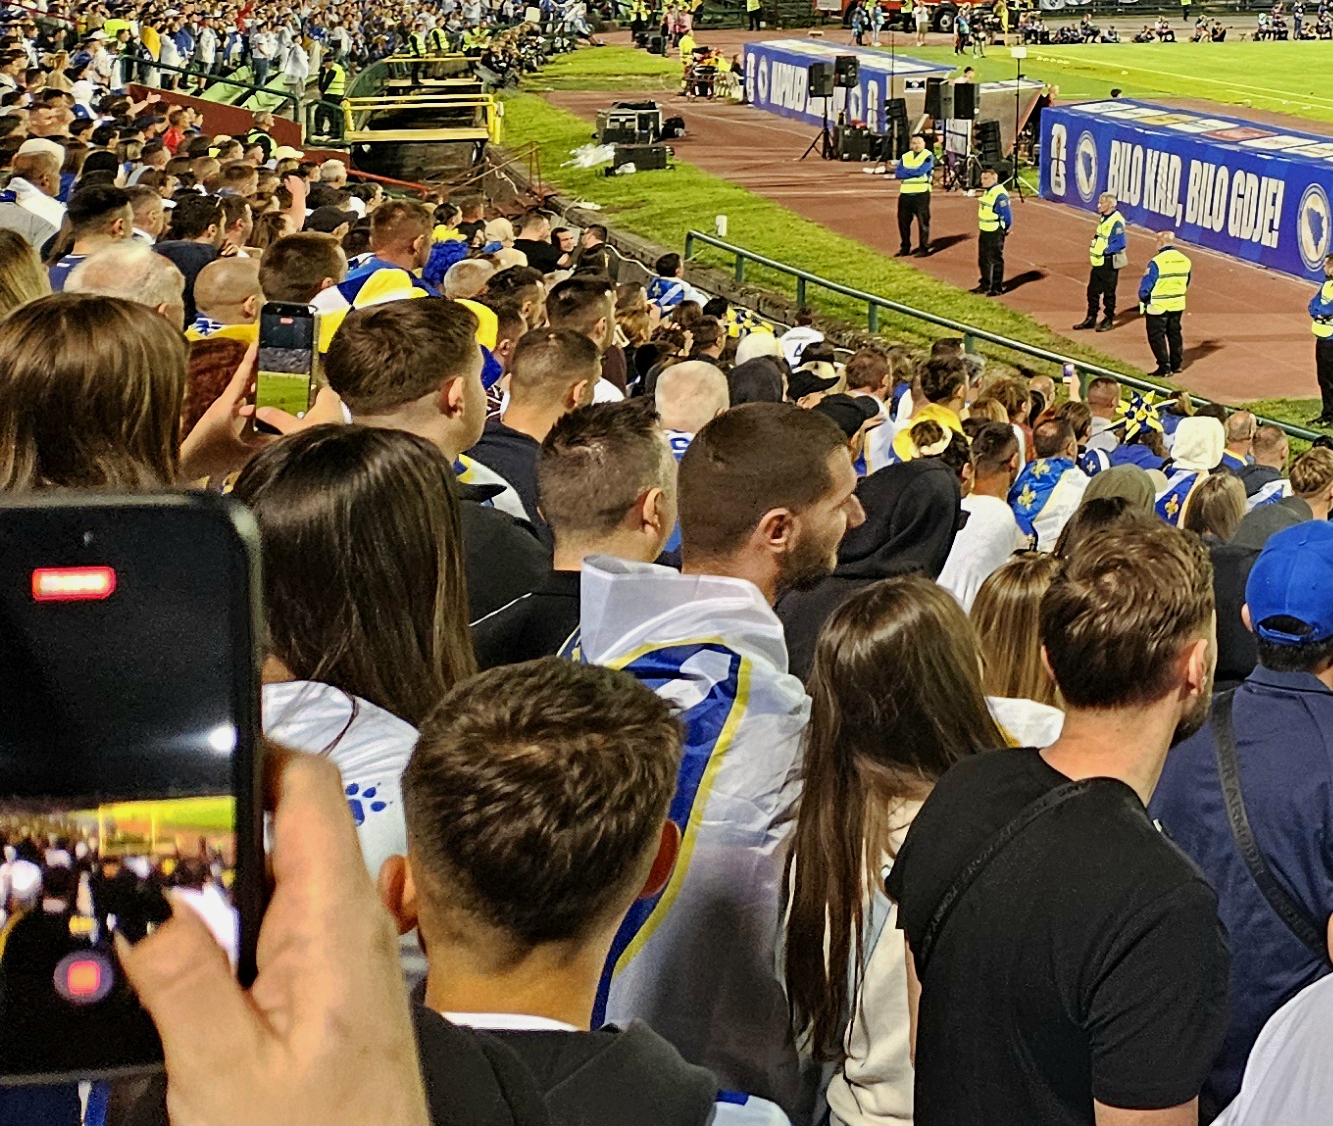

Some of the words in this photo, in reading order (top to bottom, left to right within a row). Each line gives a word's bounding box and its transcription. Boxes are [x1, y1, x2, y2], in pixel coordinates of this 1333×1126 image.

[1107, 139, 1144, 207] BILO
[1143, 148, 1183, 228] KAD,
[1185, 159, 1230, 233] BILO
[1228, 169, 1286, 249] GDJE!
